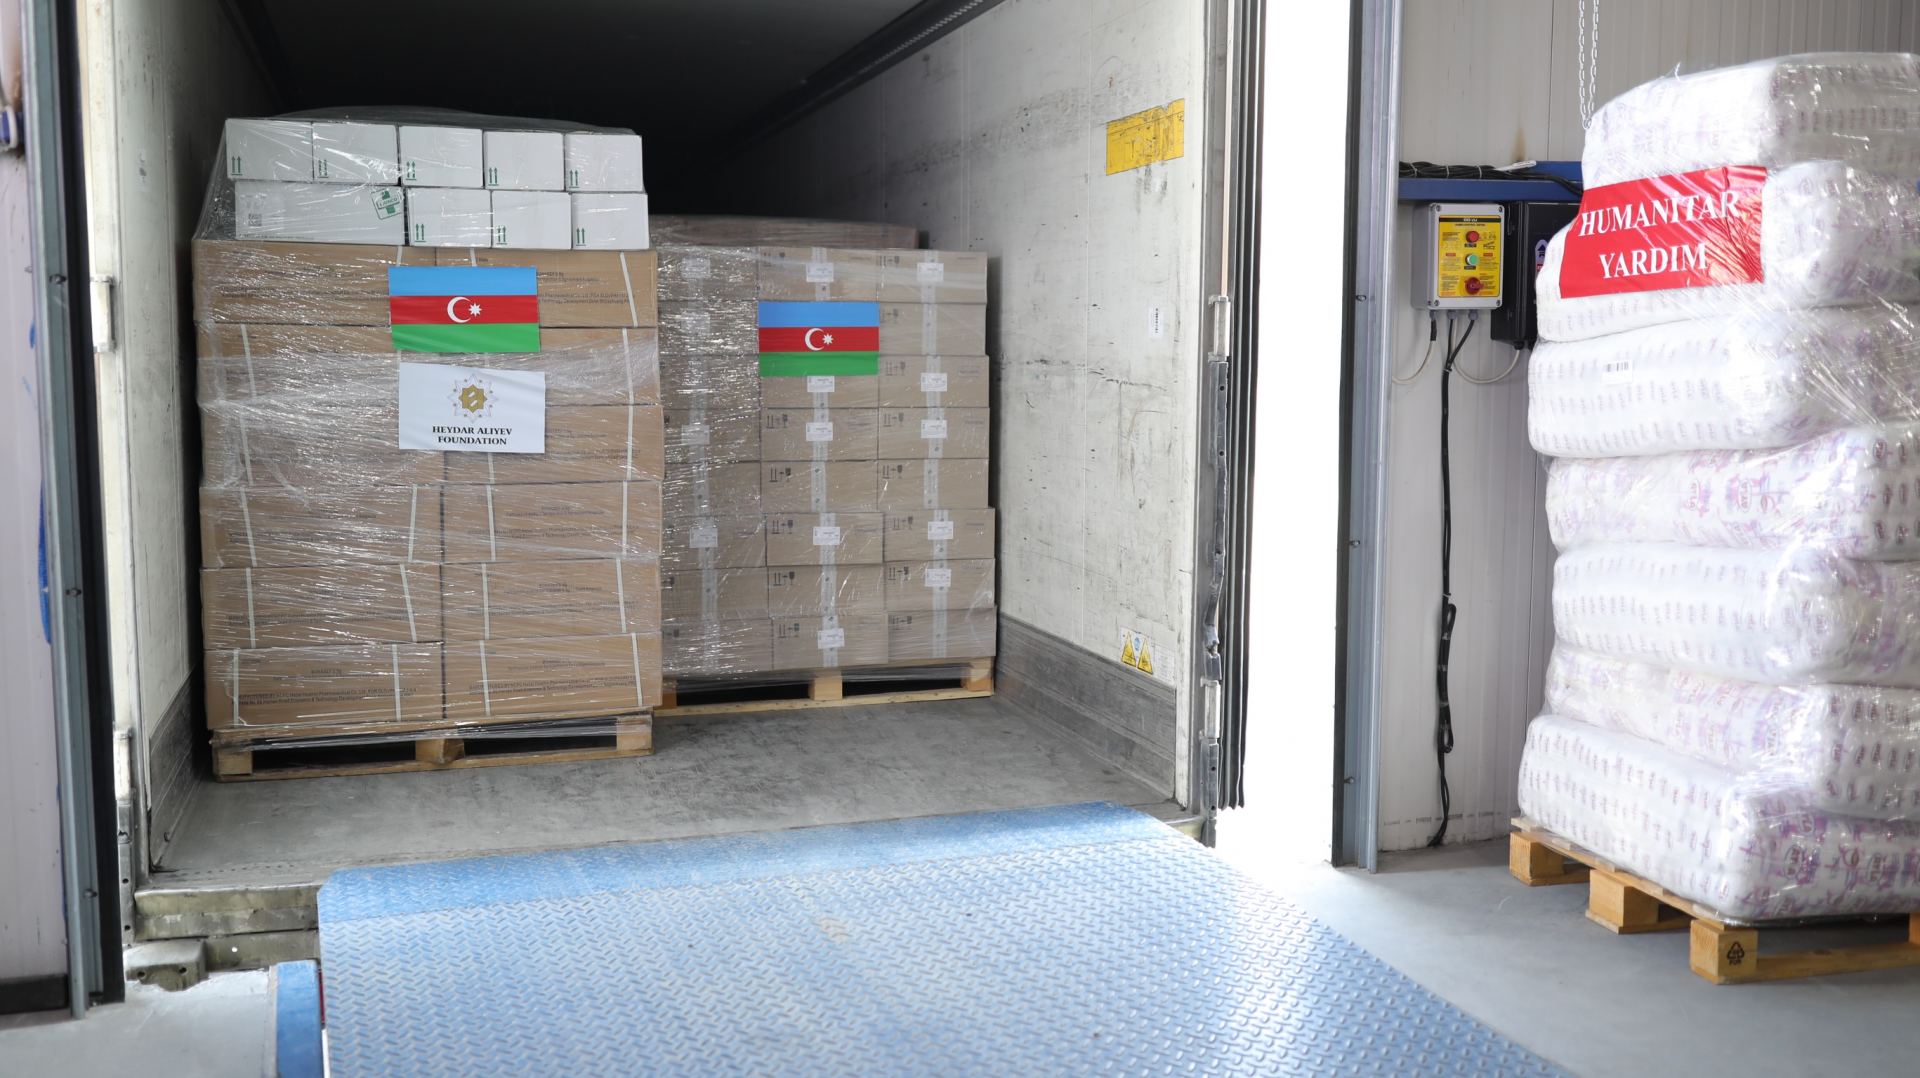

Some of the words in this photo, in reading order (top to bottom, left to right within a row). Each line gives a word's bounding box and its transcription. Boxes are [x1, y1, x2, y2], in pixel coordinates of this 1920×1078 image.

[1599, 242, 1708, 280] YARDIM
[432, 425, 475, 435] HEYDAR
[477, 427, 512, 436] ALIYEV
[437, 435, 507, 446] FOUNDATION
